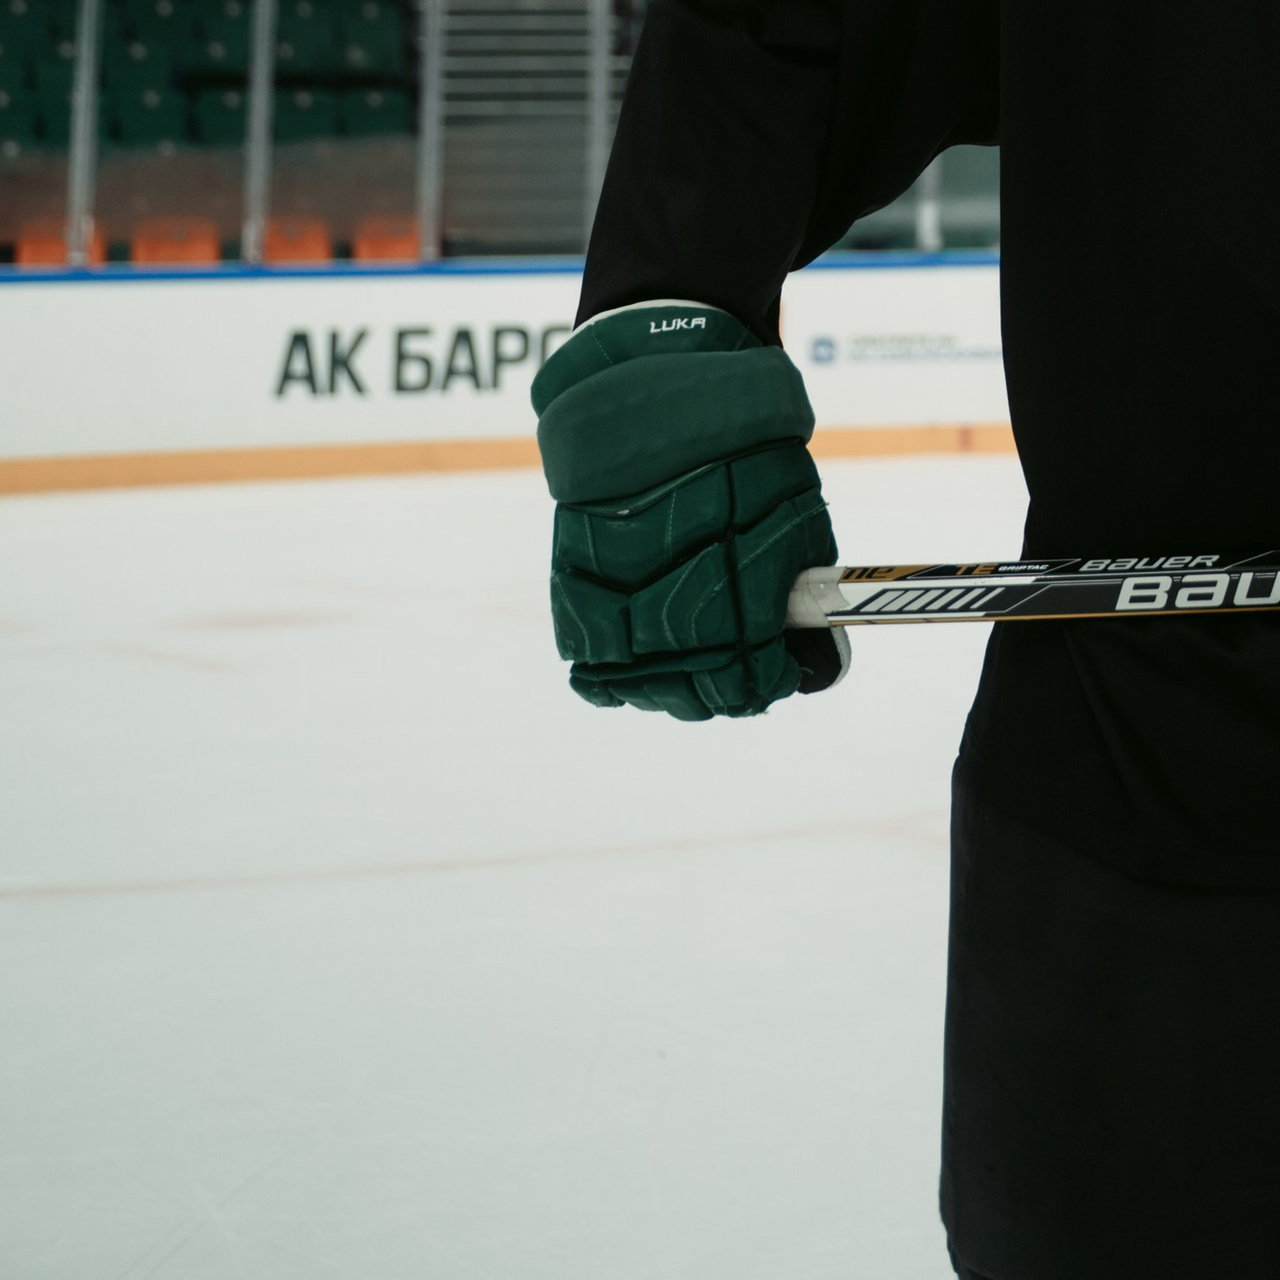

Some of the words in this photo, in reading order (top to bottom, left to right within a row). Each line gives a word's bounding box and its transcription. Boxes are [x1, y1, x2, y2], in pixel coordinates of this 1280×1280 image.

[649, 316, 707, 334] LUKA
[275, 326, 368, 397] АК
[1078, 554, 1221, 572] BAUER
